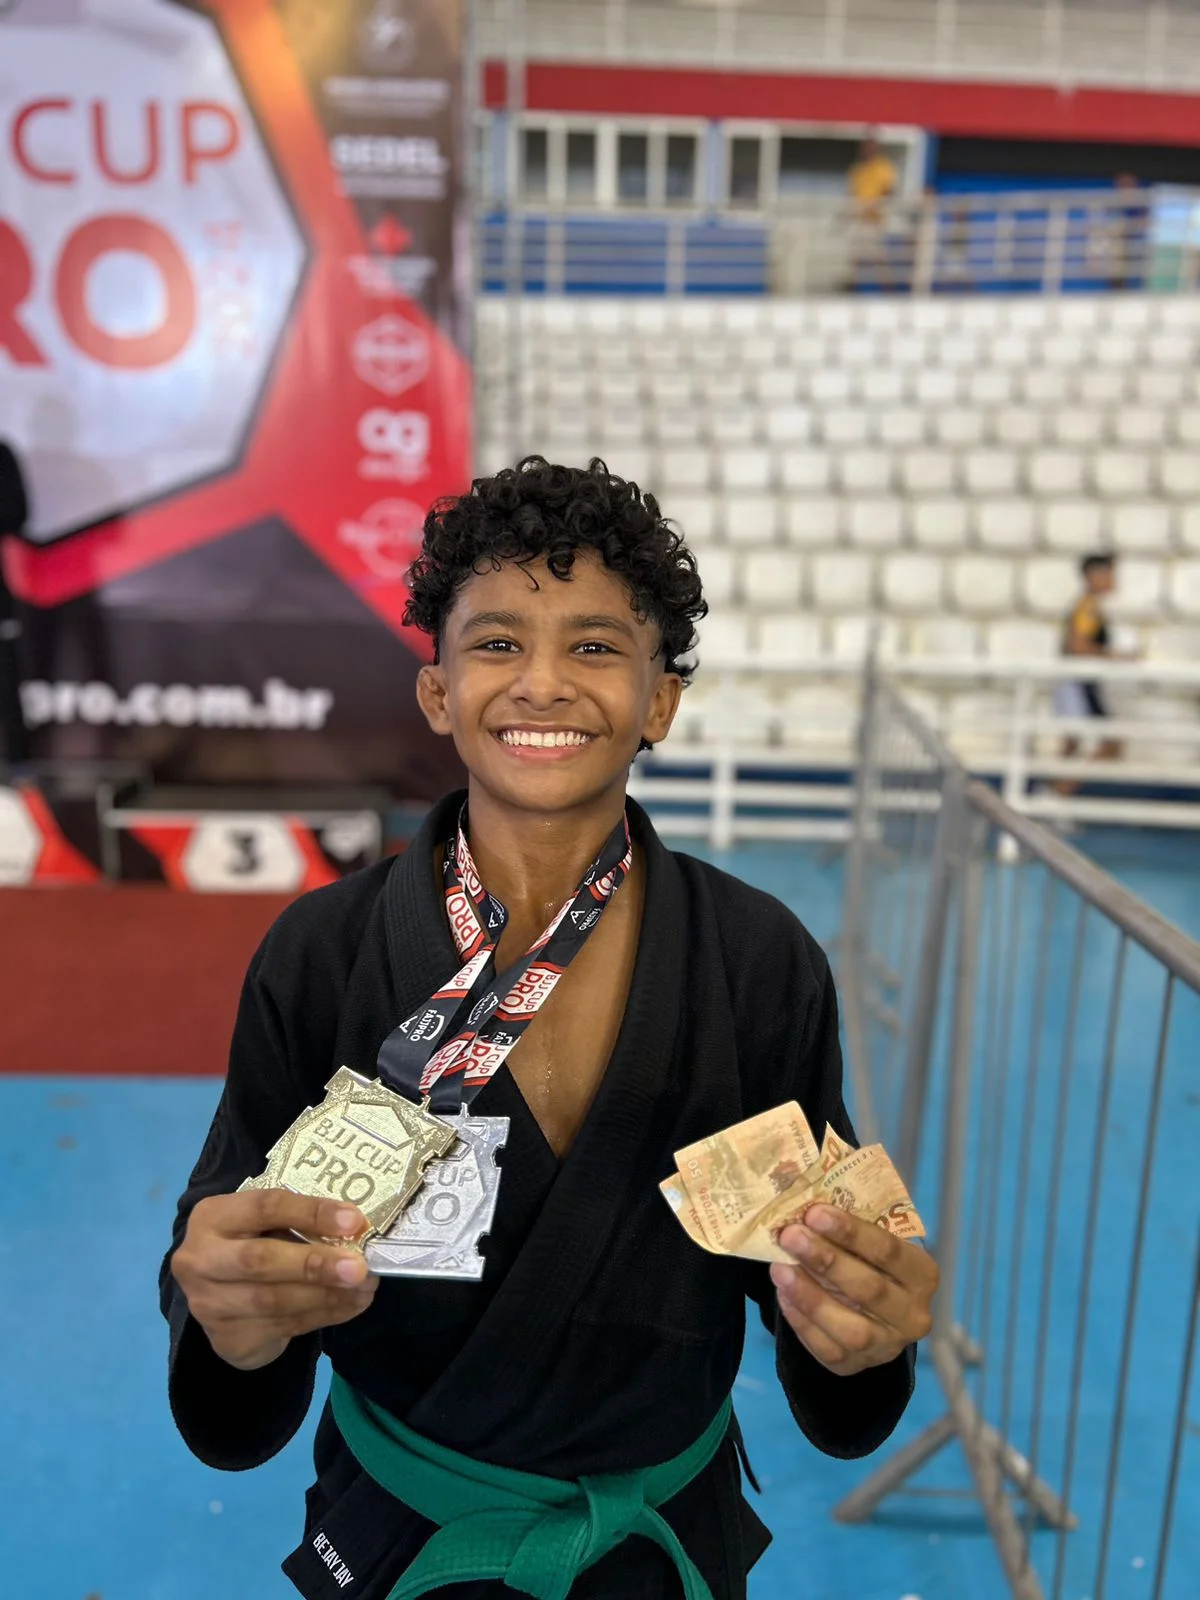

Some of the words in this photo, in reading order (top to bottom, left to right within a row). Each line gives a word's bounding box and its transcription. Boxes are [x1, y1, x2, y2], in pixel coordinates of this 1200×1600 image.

[9, 97, 242, 189] CUP
[226, 828, 261, 877] 3
[448, 896, 479, 943] PRO
[500, 970, 543, 1008] PRO
[525, 991, 544, 1011] CUP
[539, 974, 557, 990] BJJ
[313, 1117, 354, 1149] BJJ
[355, 1141, 403, 1176] CUP
[292, 1141, 376, 1207] PRO
